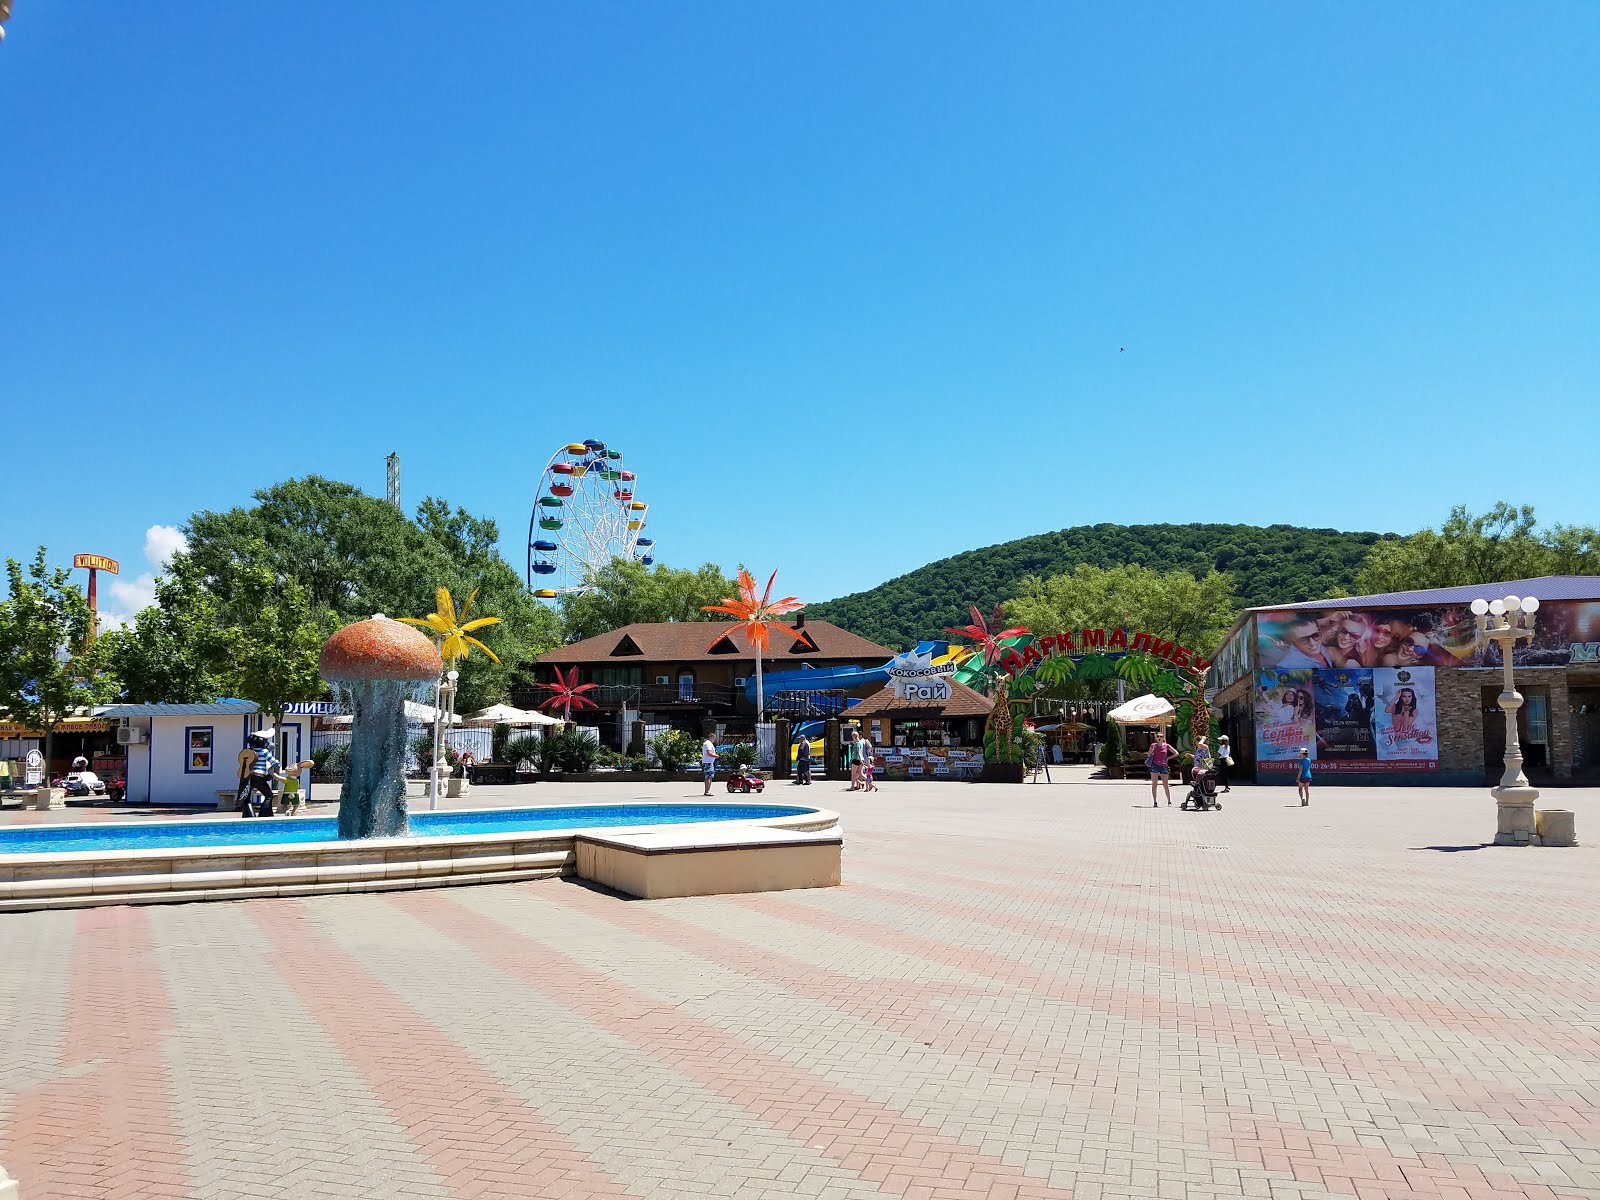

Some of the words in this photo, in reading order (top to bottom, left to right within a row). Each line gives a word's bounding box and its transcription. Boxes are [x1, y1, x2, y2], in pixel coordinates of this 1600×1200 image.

[75, 556, 118, 571] EVOLUTION
[1001, 632, 1076, 675] ПАРК
[1082, 628, 1211, 675] МАЛИБУ
[889, 662, 955, 677] КОКОСОВЫЙ
[904, 683, 947, 700] Рай
[279, 702, 349, 714] ОЛИЦИ
[60, 723, 82, 731] ЖИВОЕ
